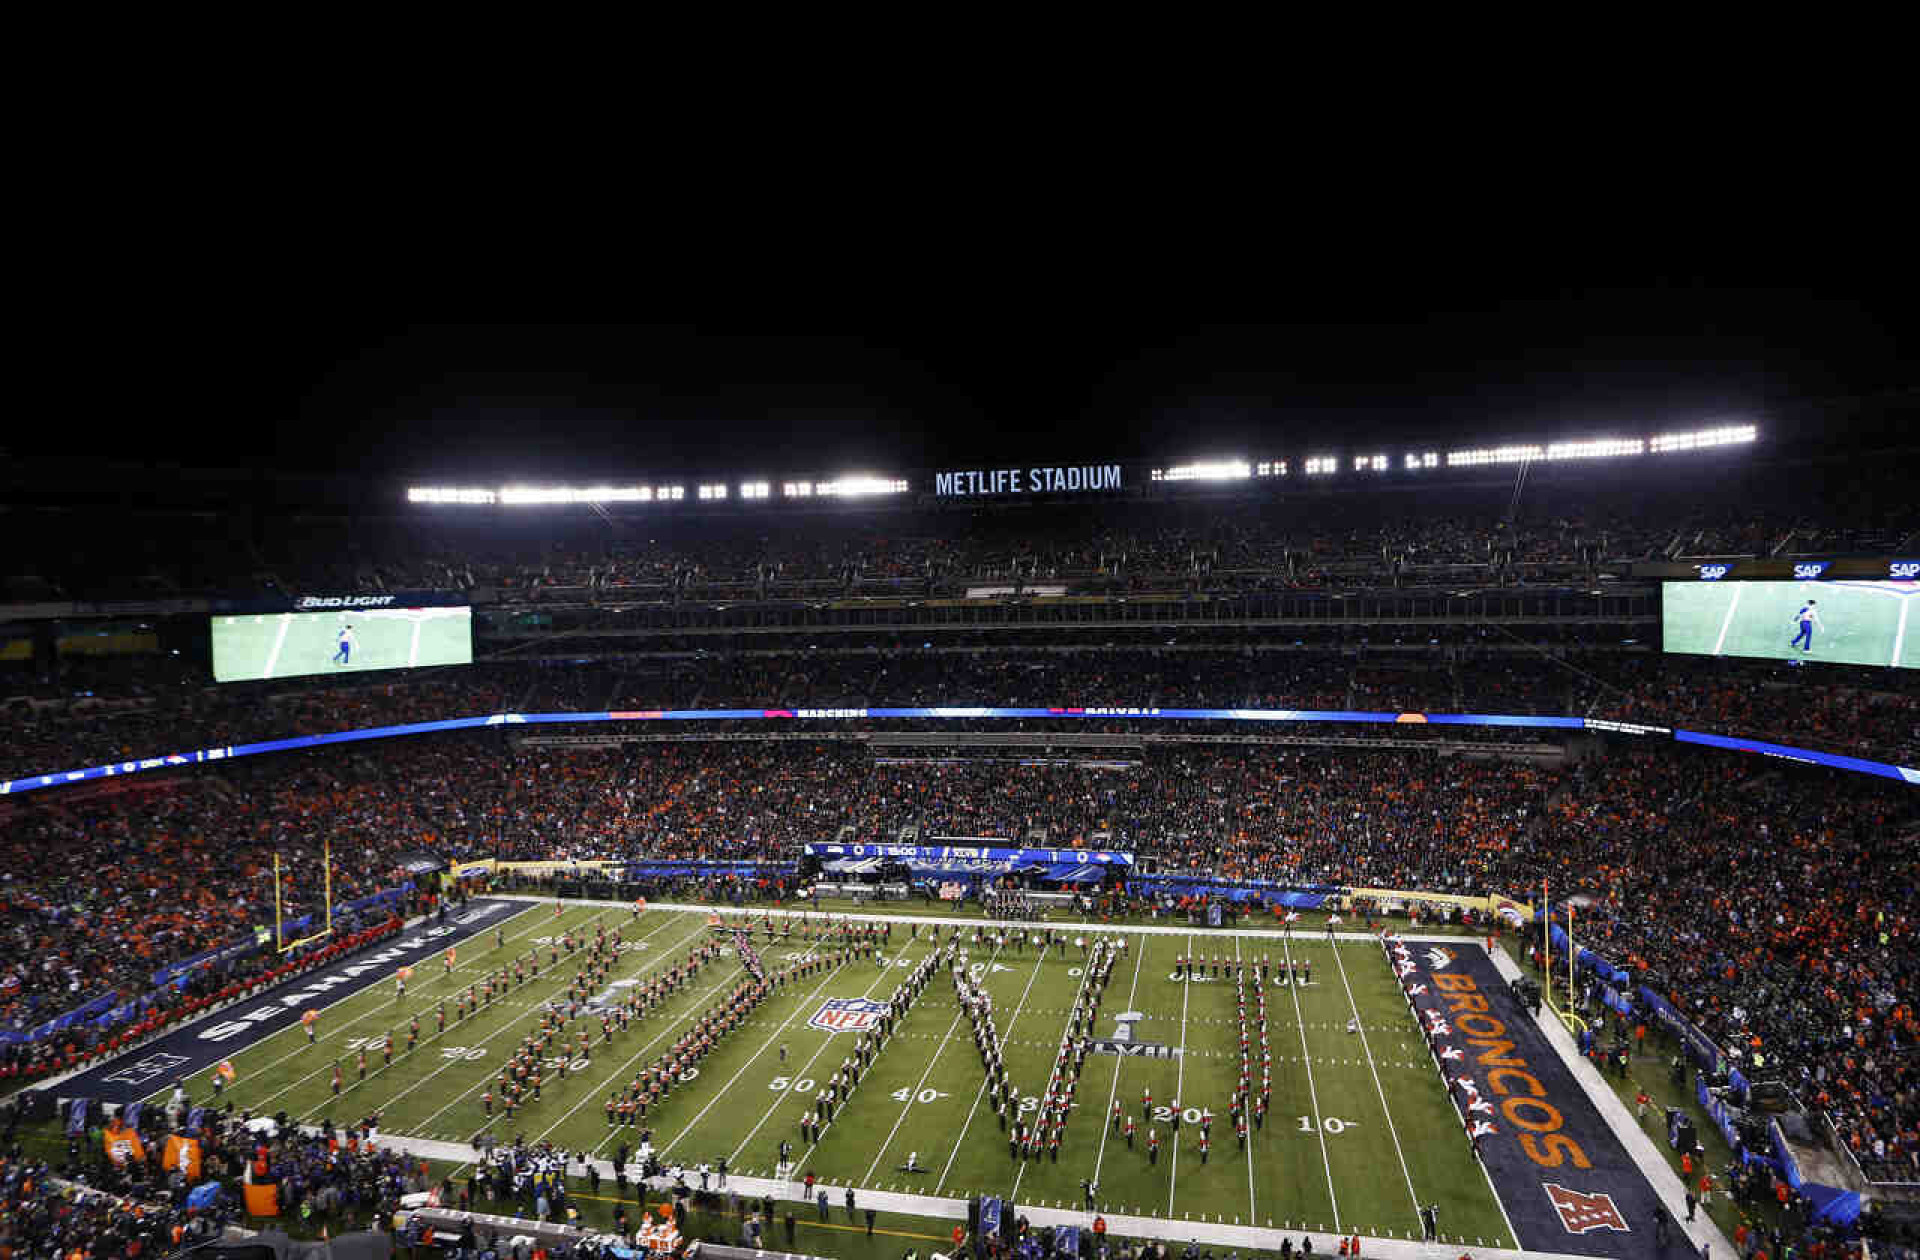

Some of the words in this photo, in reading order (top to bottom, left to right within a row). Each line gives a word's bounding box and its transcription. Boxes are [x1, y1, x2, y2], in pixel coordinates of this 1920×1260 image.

[935, 470, 1021, 496] METLIFE
[1029, 464, 1122, 492] STADIUM
[1700, 566, 1727, 579] SAP
[1794, 565, 1822, 577] SAP
[1889, 563, 1920, 577] SAP
[301, 597, 341, 608] BUD
[343, 595, 396, 606] LIGHT
[198, 926, 458, 1042] SEAHAWKS
[818, 1010, 870, 1028] NFL
[1430, 972, 1594, 1169] BRONCOS
[768, 1076, 816, 1092] 50
[890, 1087, 938, 1103] 40
[1152, 1106, 1202, 1124] 20
[1297, 1115, 1346, 1135] 10
